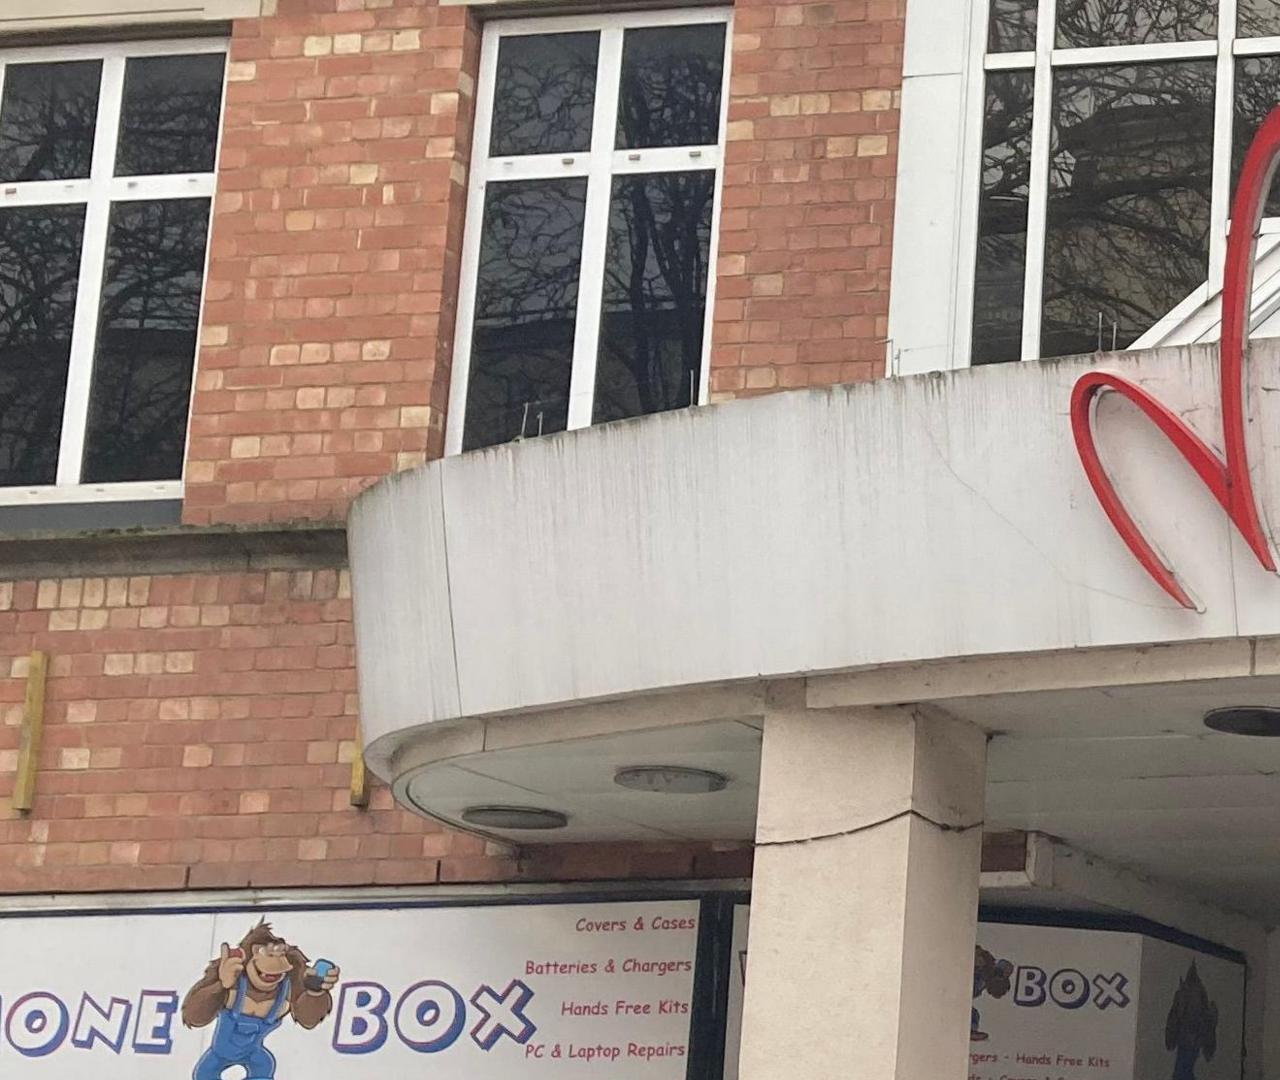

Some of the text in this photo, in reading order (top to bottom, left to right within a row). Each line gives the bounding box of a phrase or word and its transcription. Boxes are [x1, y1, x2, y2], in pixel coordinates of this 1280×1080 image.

[575, 916, 696, 932] Covers & Cases
[525, 958, 692, 976] Batteries & Chargers
[1013, 965, 1131, 1010] BOX
[561, 1000, 689, 1016] Hands Free Kits
[0, 978, 538, 1058] ONE BOX
[525, 1042, 685, 1062] PC & Laptop Repairs
[1016, 1053, 1051, 1065] Hands
[1056, 1055, 1083, 1066] Free
[1088, 1056, 1110, 1068] Kits
